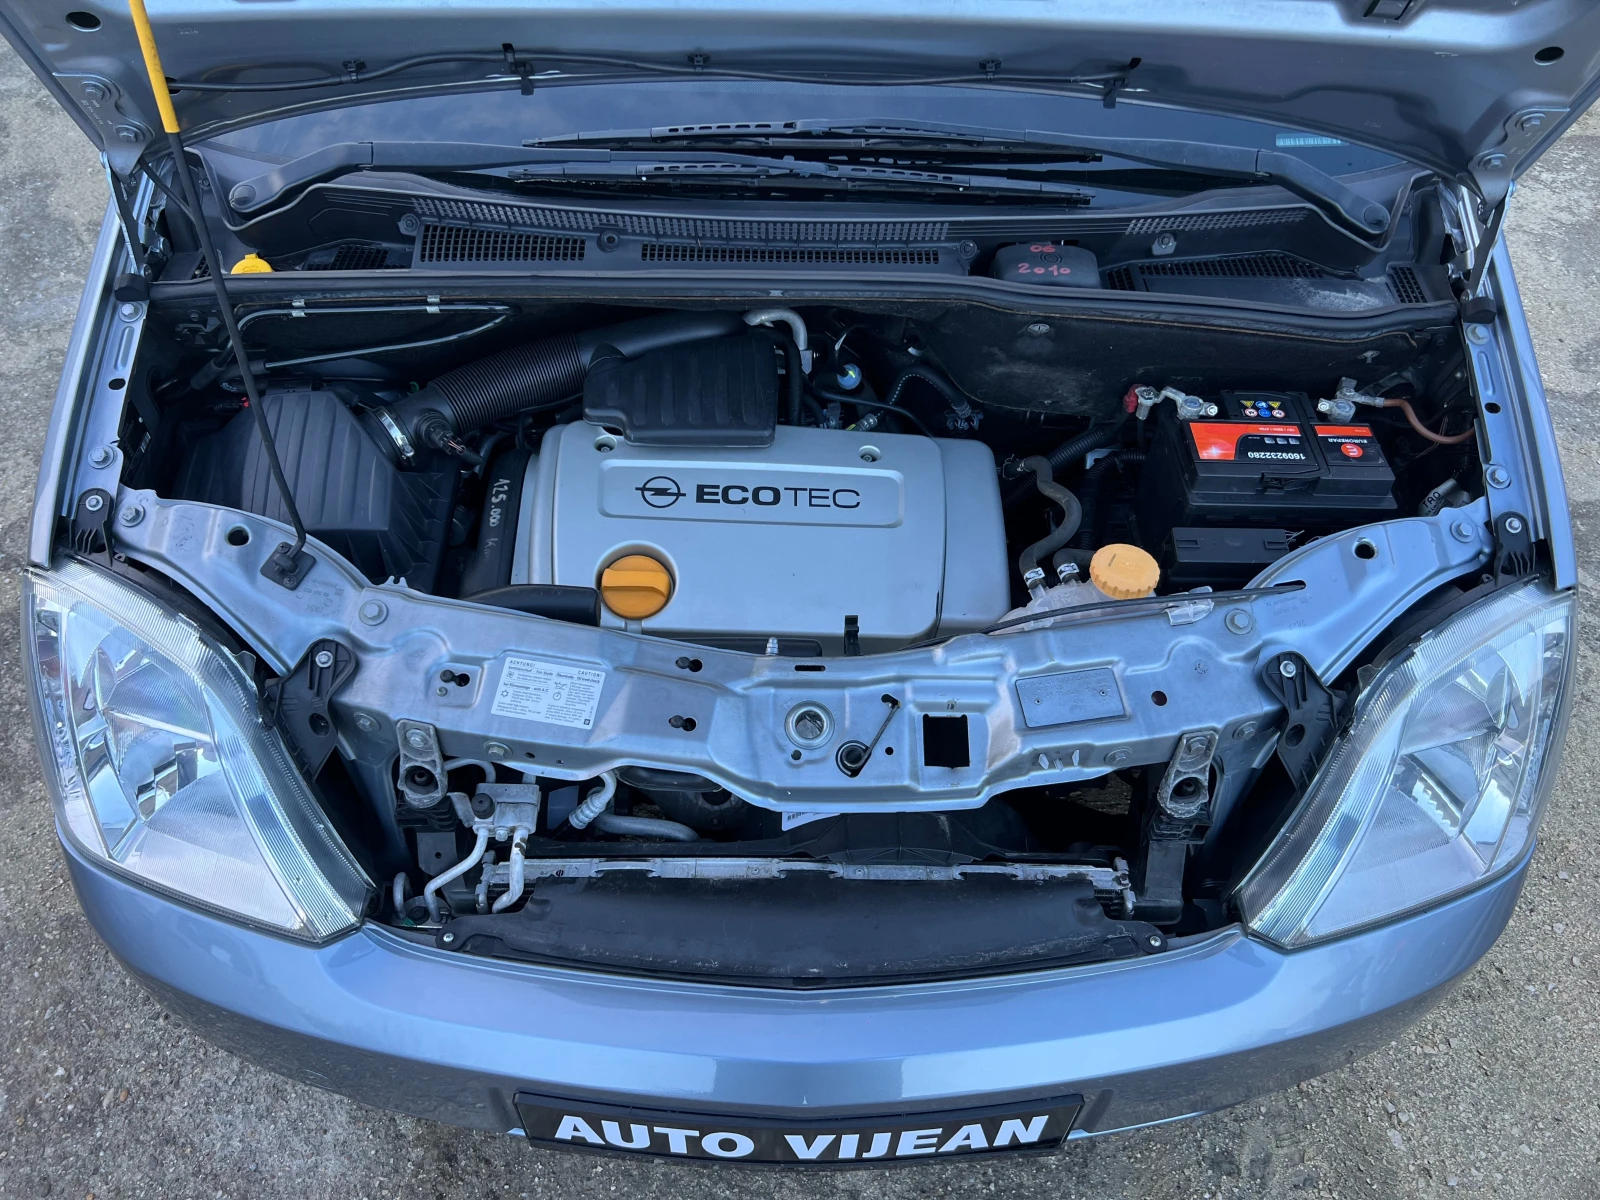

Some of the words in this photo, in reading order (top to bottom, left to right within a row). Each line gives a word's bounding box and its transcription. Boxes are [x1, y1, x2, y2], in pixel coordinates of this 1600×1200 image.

[1029, 244, 1056, 253] 06
[1017, 262, 1071, 276] 2010
[1247, 451, 1306, 460] 1609232280
[695, 483, 861, 509] ECOTEC
[509, 659, 536, 668] ACHTUNG!
[577, 670, 603, 678] CAUTION!
[553, 1114, 756, 1159] AUTO
[783, 1114, 1050, 1160] VIJEAN
